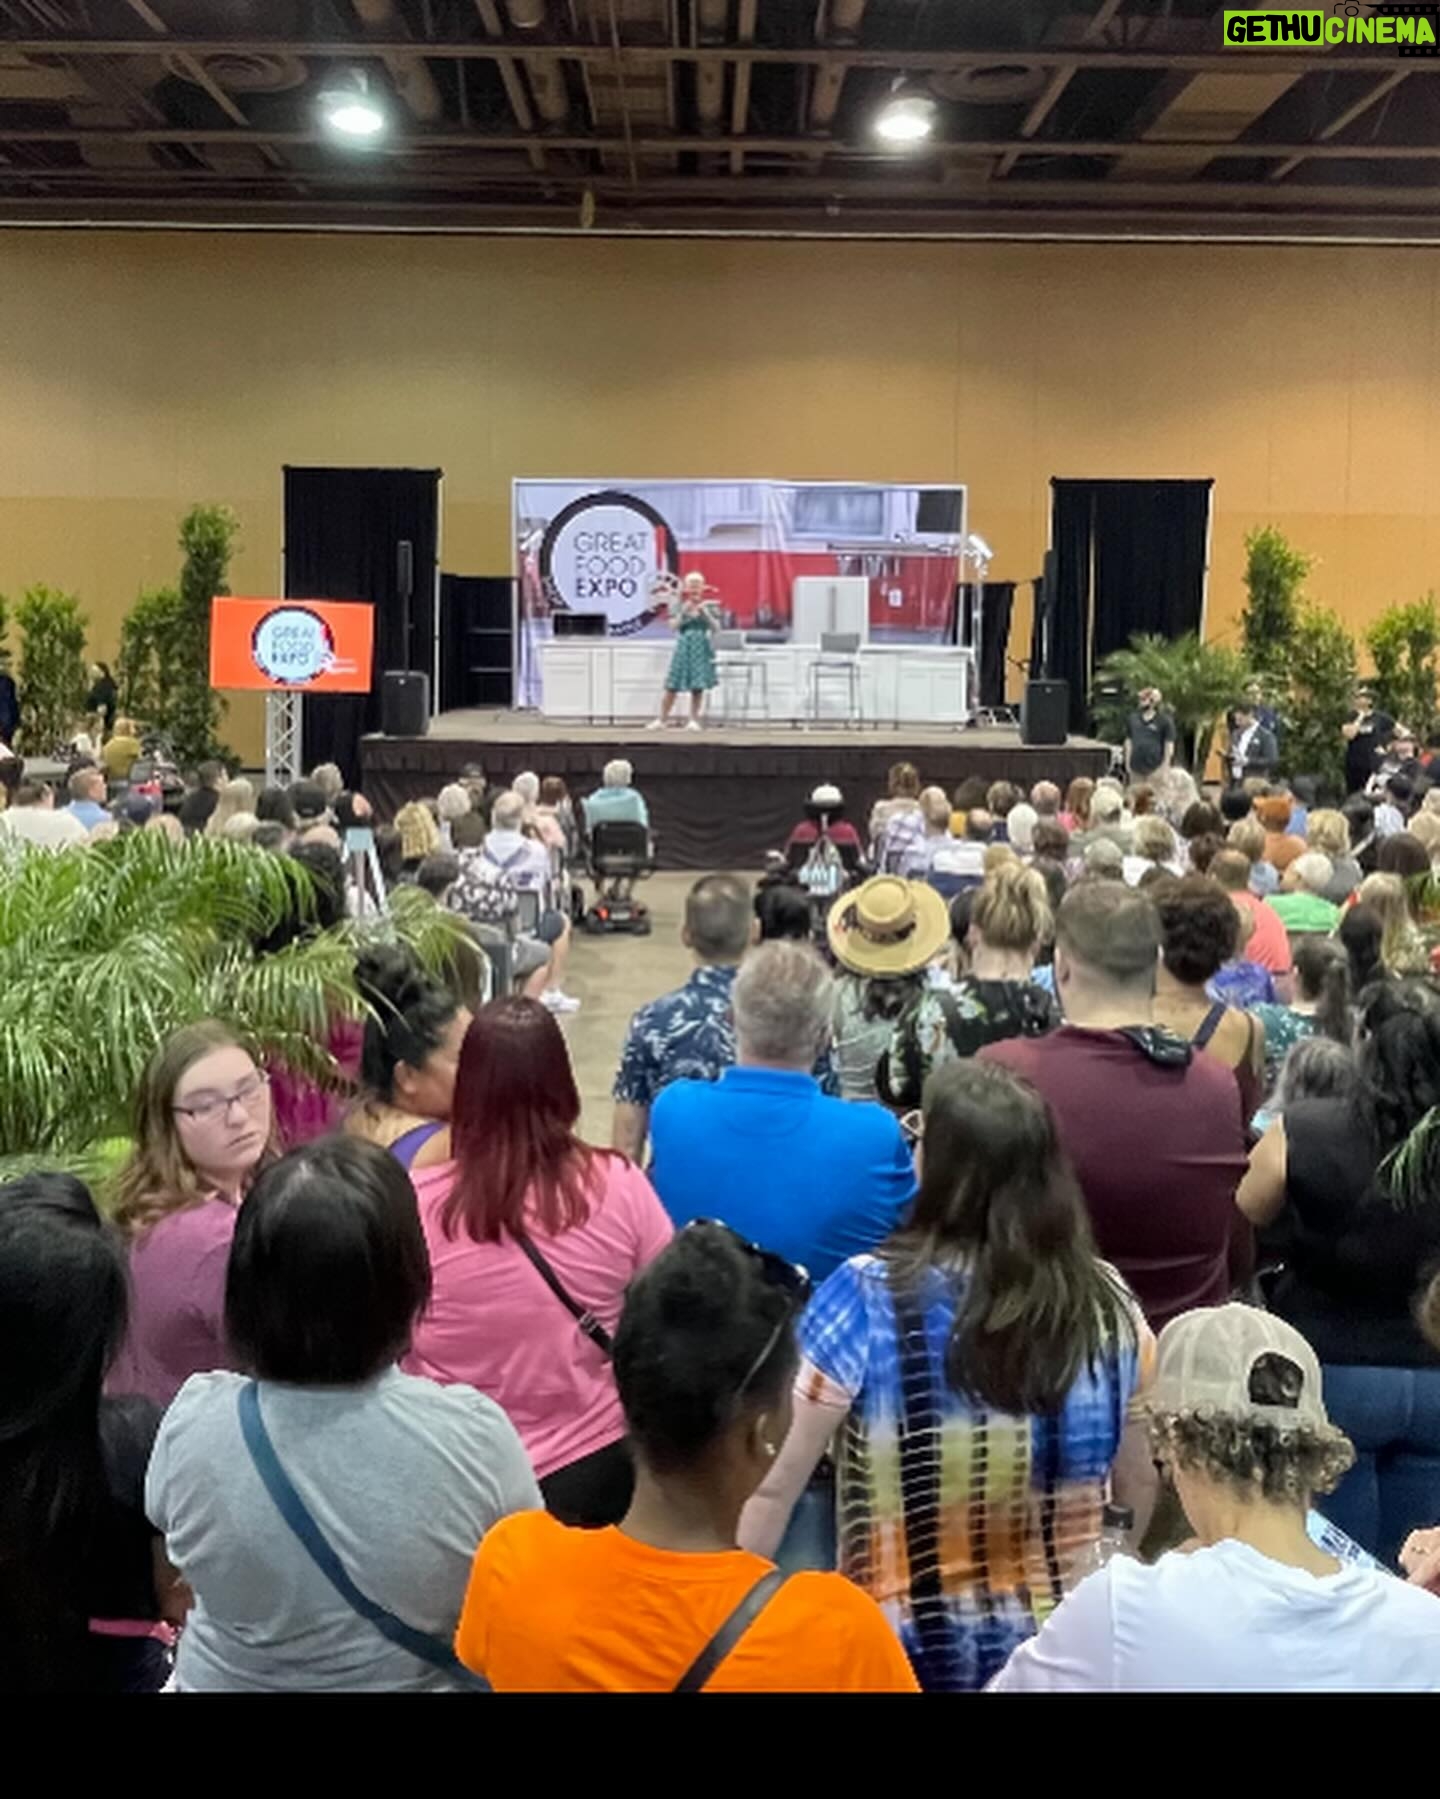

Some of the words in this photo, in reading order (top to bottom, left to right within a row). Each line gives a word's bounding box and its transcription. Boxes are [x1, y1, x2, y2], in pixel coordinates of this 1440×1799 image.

[573, 531, 648, 553] GREAT
[575, 555, 646, 576] FOOD
[575, 577, 637, 598] EXPO
